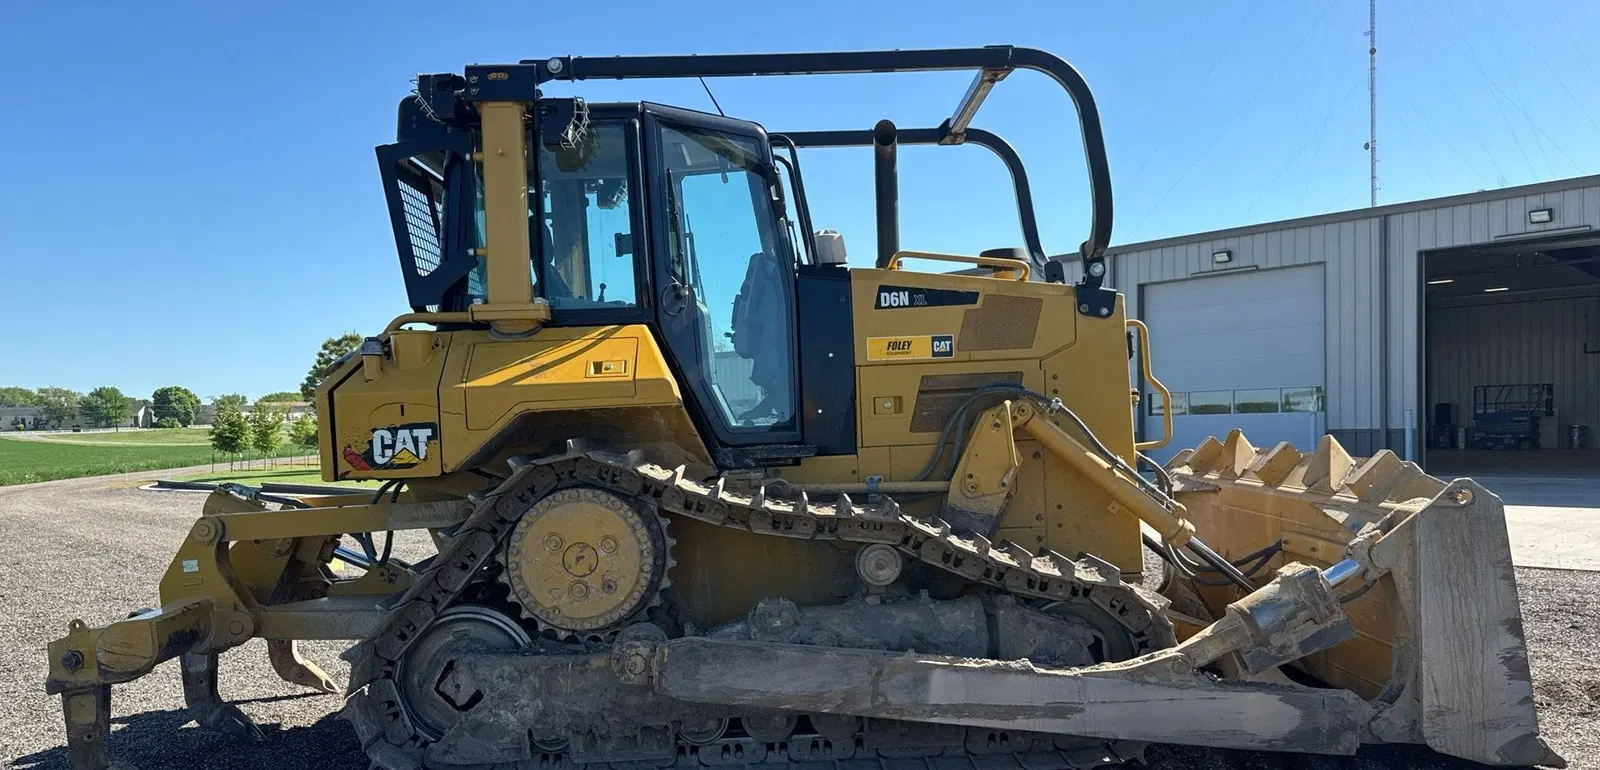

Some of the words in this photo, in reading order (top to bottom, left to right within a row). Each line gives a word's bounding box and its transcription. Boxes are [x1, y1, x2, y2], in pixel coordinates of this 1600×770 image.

[880, 291, 910, 307] D6N
[913, 294, 928, 306] XL
[887, 340, 912, 351] FOLEY
[933, 341, 951, 352] CAT
[372, 428, 432, 465] CAT
